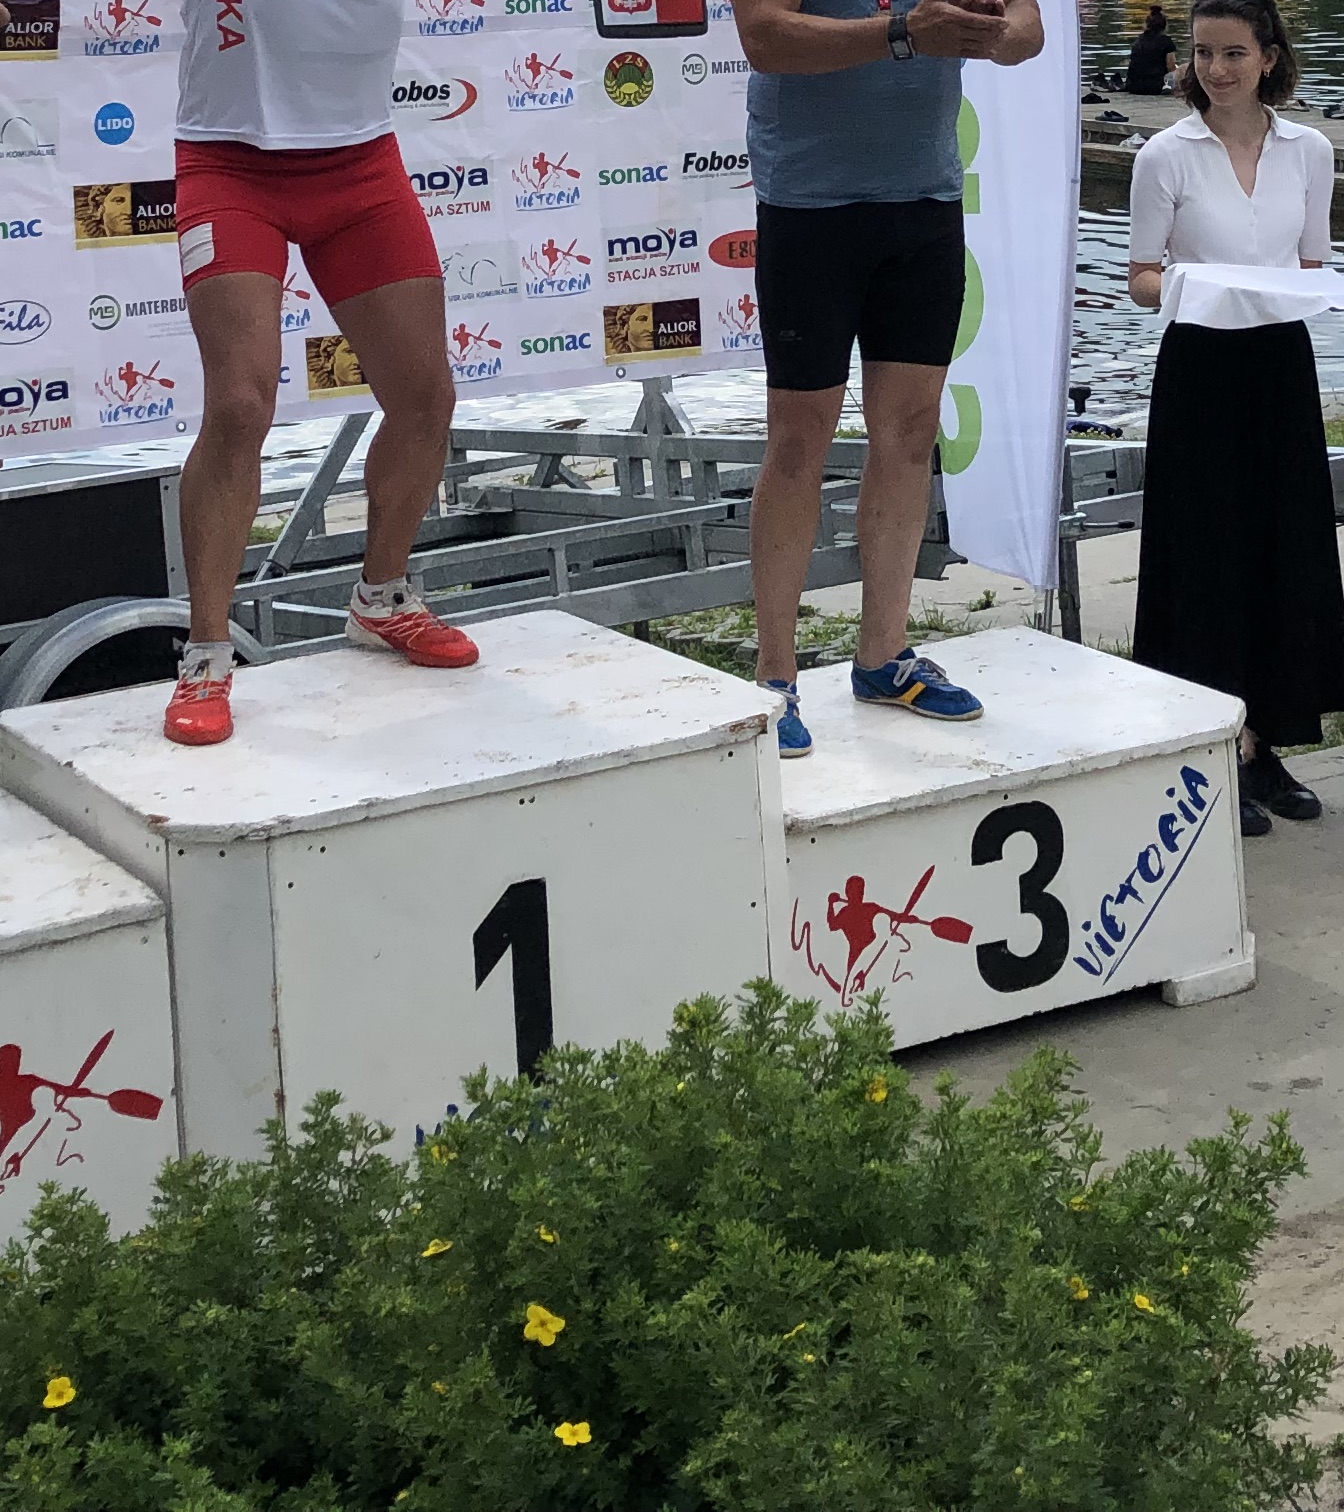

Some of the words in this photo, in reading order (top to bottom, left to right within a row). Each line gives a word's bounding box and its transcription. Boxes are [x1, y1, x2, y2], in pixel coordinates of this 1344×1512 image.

[5, 21, 54, 34] ALIOR
[5, 35, 47, 48] BANK
[712, 60, 754, 74] MATER
[392, 80, 451, 103] obos
[97, 116, 133, 131] LIDO
[682, 150, 749, 173] Fobos
[599, 165, 669, 186] sonac
[447, 200, 491, 216] SZTUM
[608, 268, 657, 283] STACJA
[659, 261, 701, 276] SZTUM
[125, 297, 186, 317] MATERBU
[658, 319, 698, 334] ALIOR
[520, 332, 592, 355] sonac
[659, 333, 693, 347] BANK
[21, 416, 73, 435] SZTUM
[971, 800, 1070, 994] 3
[472, 876, 554, 1088] 1
